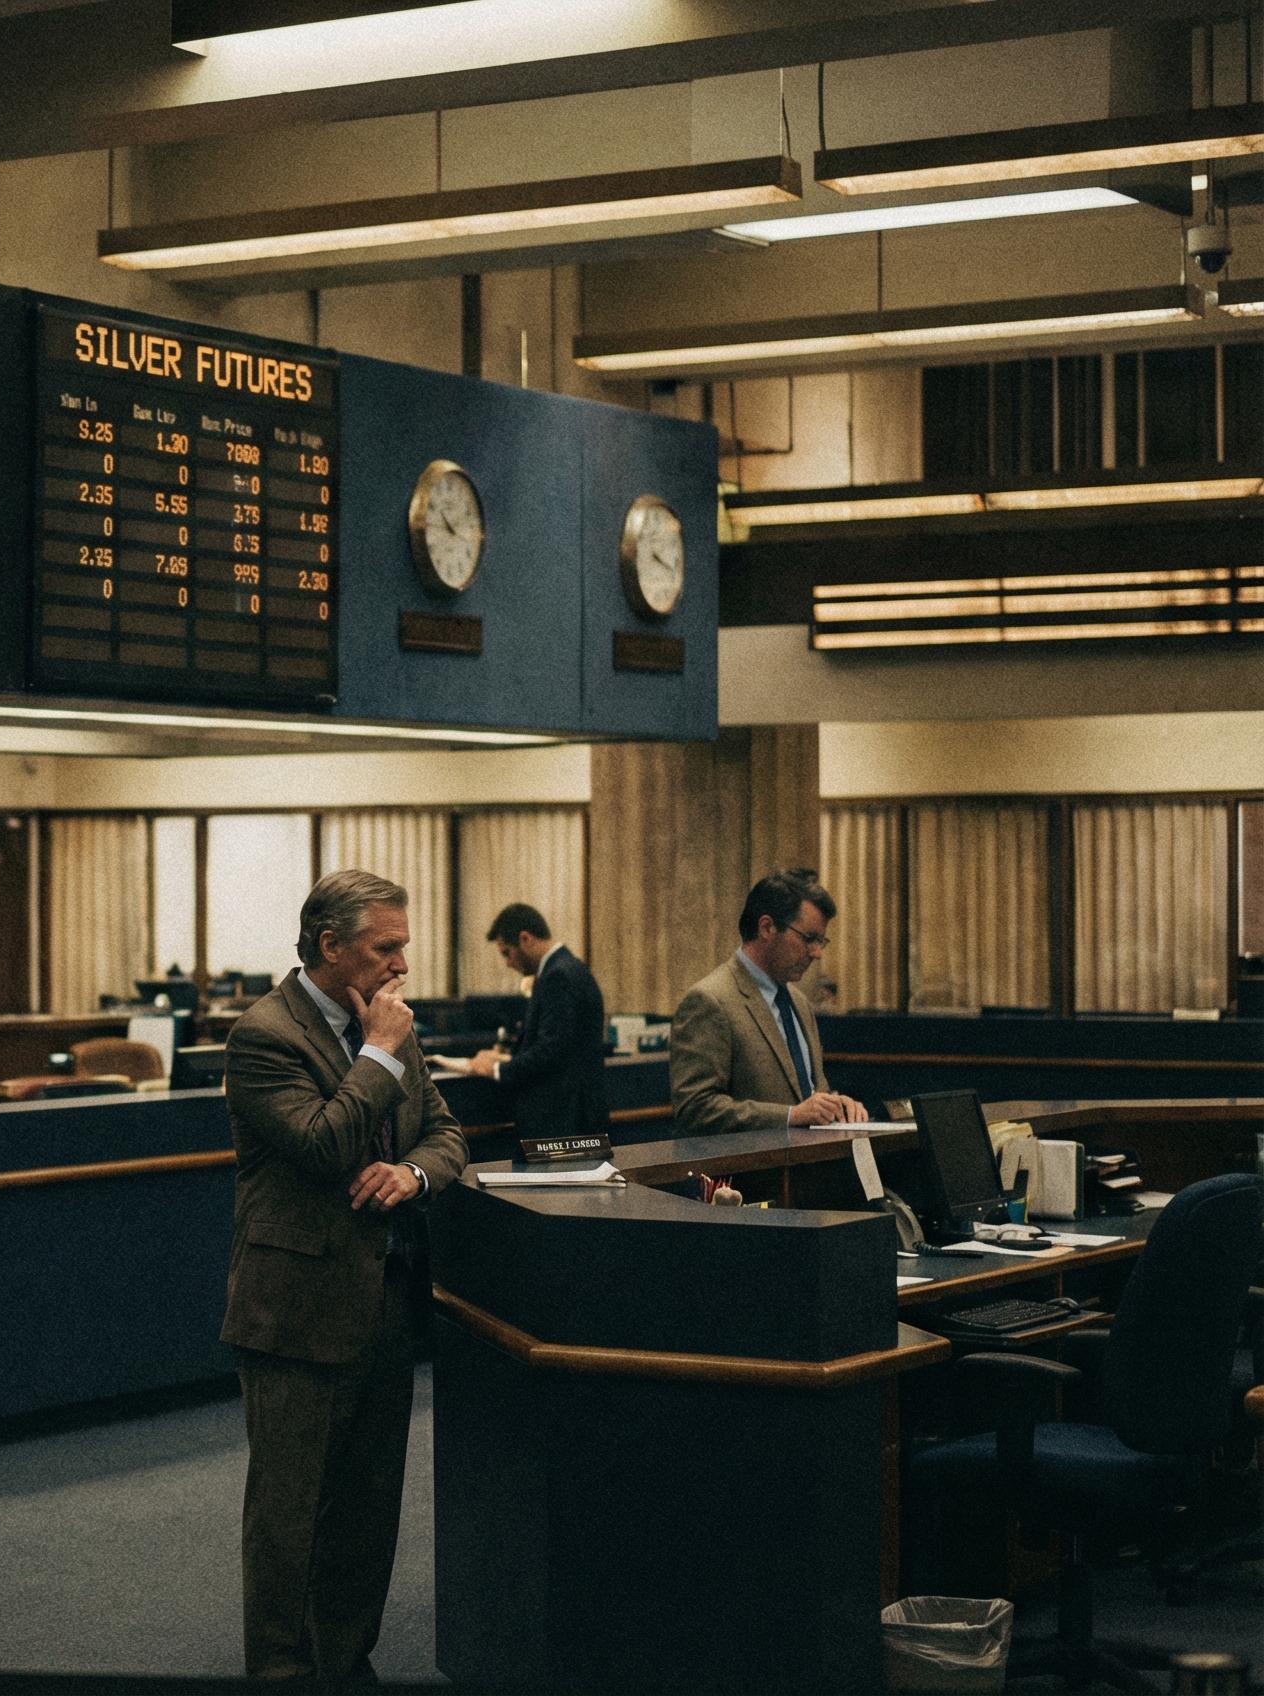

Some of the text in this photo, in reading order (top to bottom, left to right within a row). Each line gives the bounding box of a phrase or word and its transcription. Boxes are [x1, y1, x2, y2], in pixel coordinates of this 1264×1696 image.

[75, 322, 312, 402] SILVER FUTURES
[103, 453, 114, 475] 0
[178, 465, 189, 486] 0
[319, 485, 330, 505] 0
[103, 516, 114, 537] 0
[178, 526, 189, 546] 0
[319, 543, 329, 563] 0
[102, 578, 329, 621] 0 0 0 0
